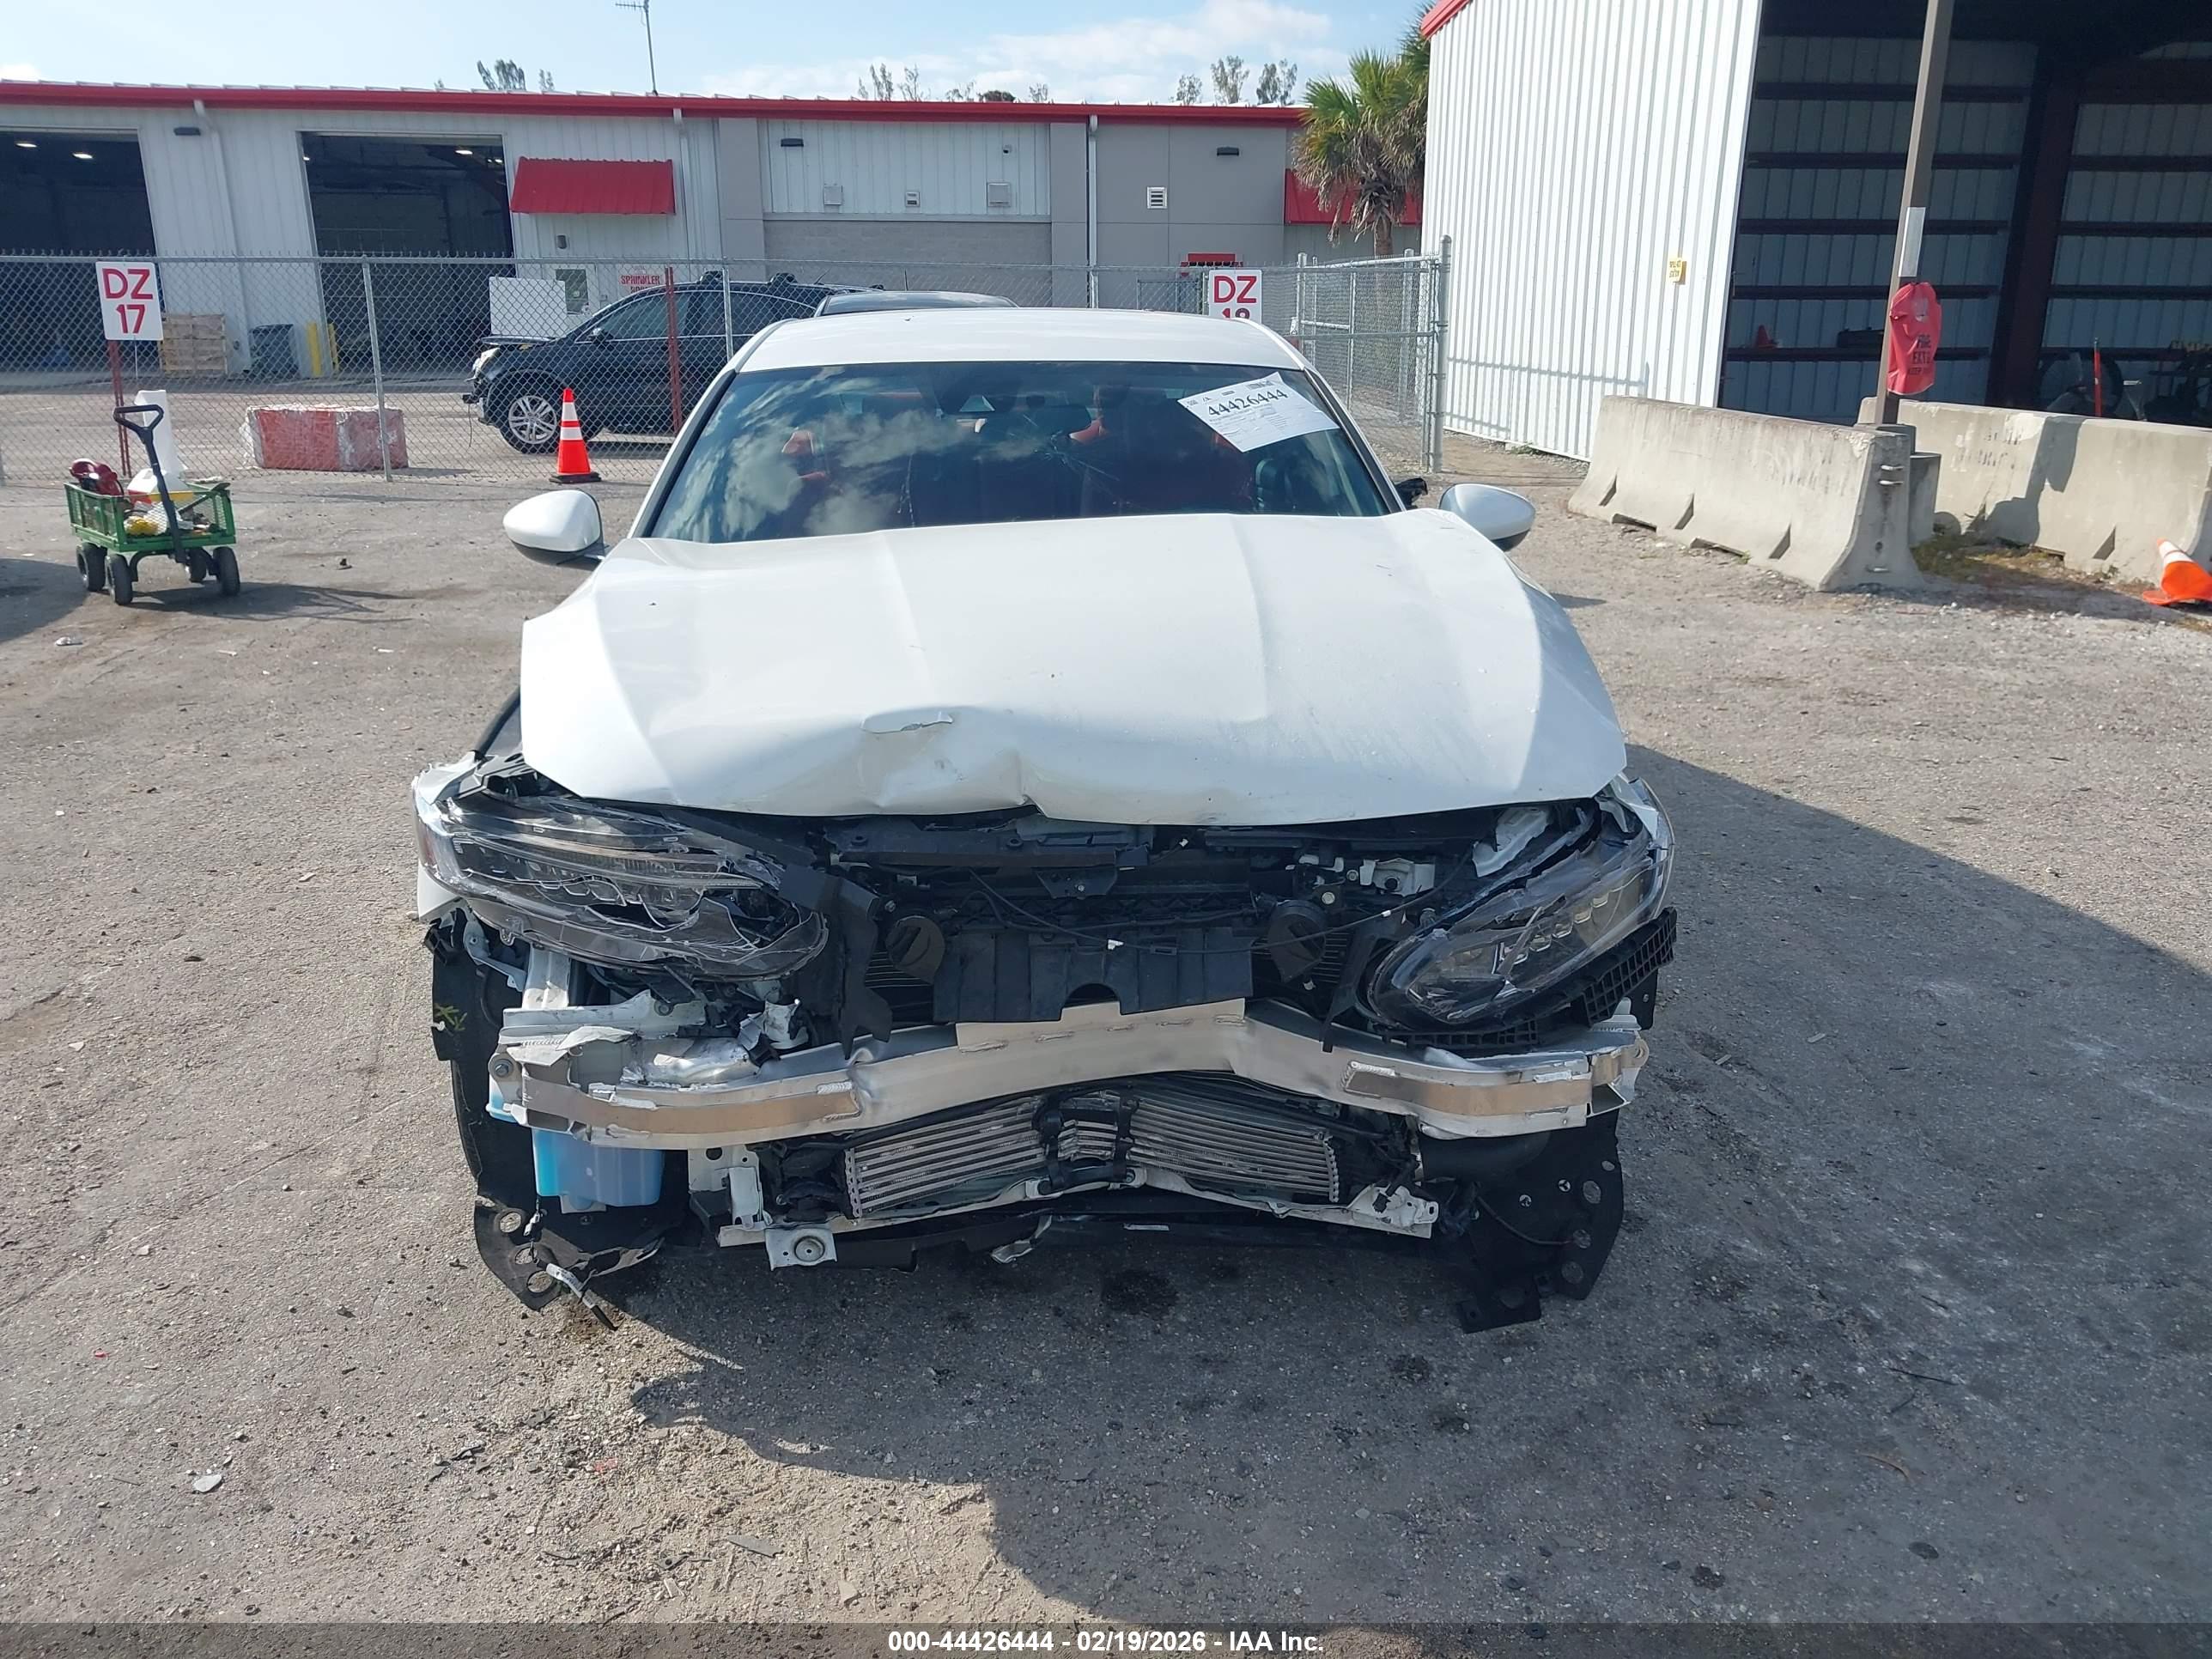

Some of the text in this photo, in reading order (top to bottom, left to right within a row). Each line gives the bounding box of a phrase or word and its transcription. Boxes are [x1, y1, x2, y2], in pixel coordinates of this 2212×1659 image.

[101, 267, 154, 300] DZ
[620, 275, 660, 285] SPRINKLER
[1213, 275, 1257, 304] DZ
[115, 303, 146, 334] 17
[1207, 388, 1289, 416] 44426444
